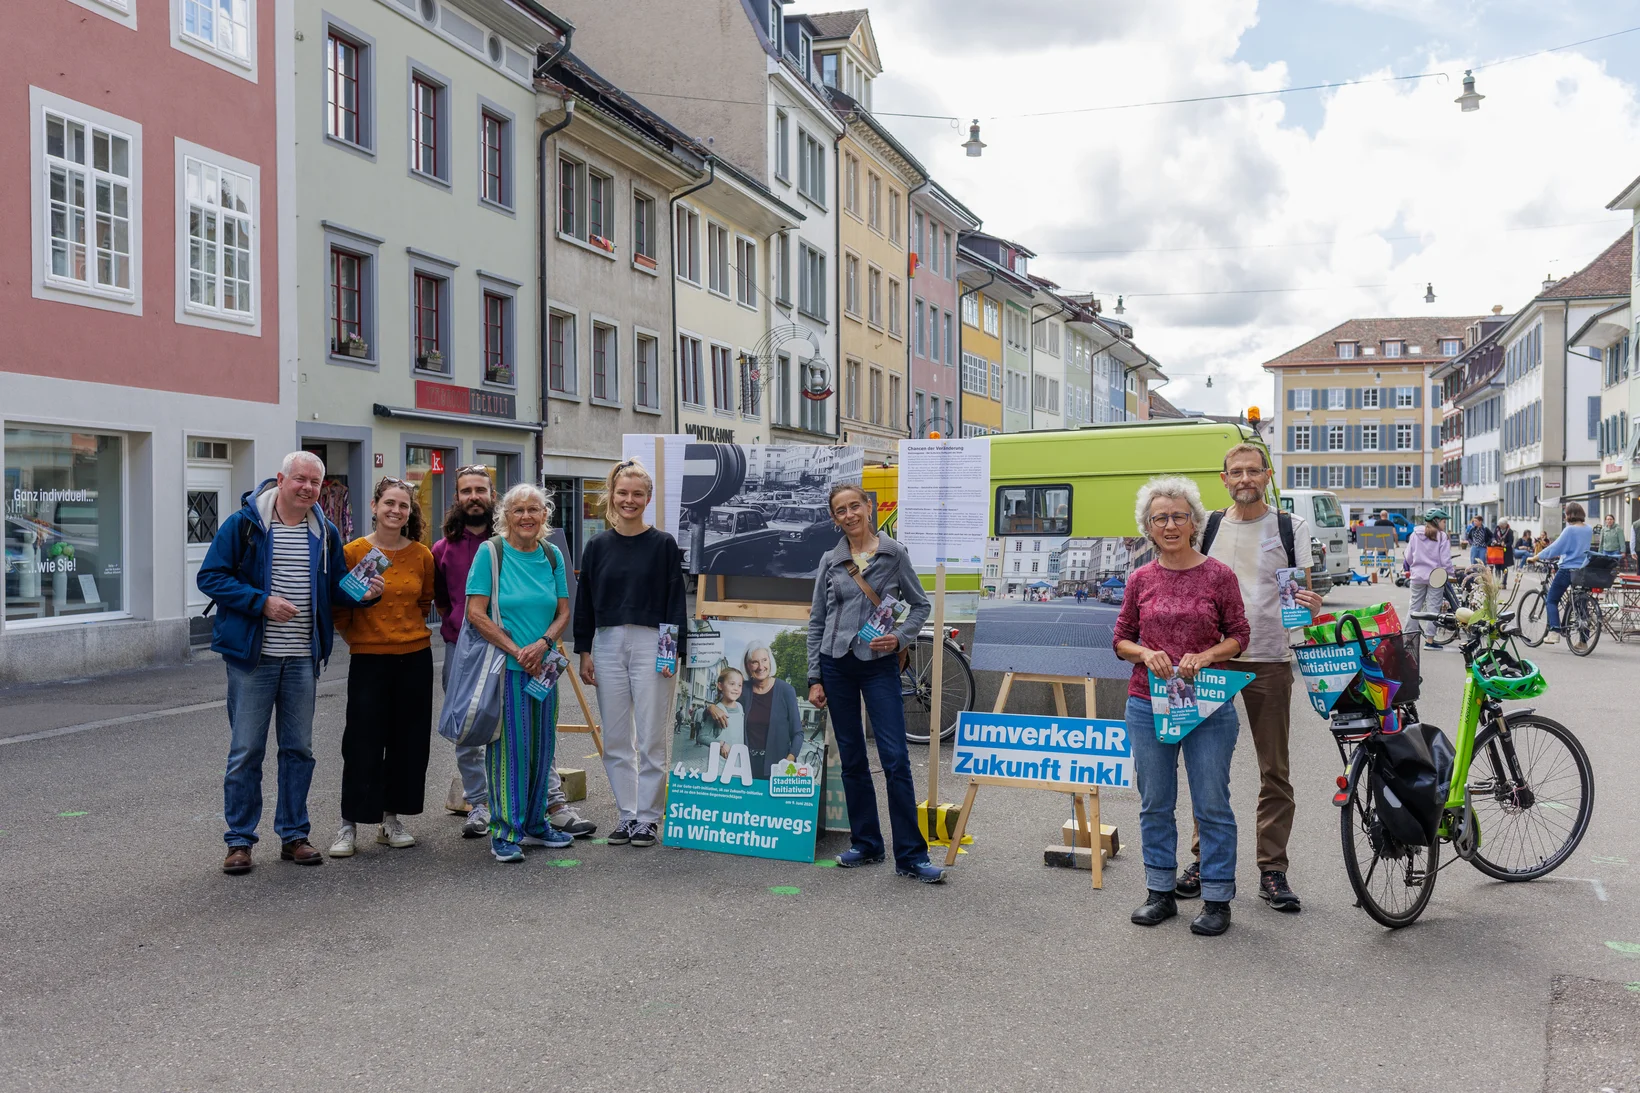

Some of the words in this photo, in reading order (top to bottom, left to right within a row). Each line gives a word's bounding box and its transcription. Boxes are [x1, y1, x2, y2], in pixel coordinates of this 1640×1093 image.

[471, 392, 508, 415] TEEKULT
[685, 423, 735, 445] WINTIKANNE
[376, 454, 383, 464] 21
[13, 488, 38, 502] Ganz
[39, 488, 94, 502] individuell...
[57, 557, 76, 572] Sie!
[963, 723, 1126, 751] umverkehR
[701, 741, 753, 787] JA
[954, 751, 1062, 781] Zukunft
[1069, 759, 1129, 787] inkl.
[773, 777, 811, 785] Stadtklima
[669, 802, 719, 823] Sicher
[721, 810, 812, 835] unterwegs
[667, 822, 684, 839] in
[687, 824, 779, 849] Winterthur
